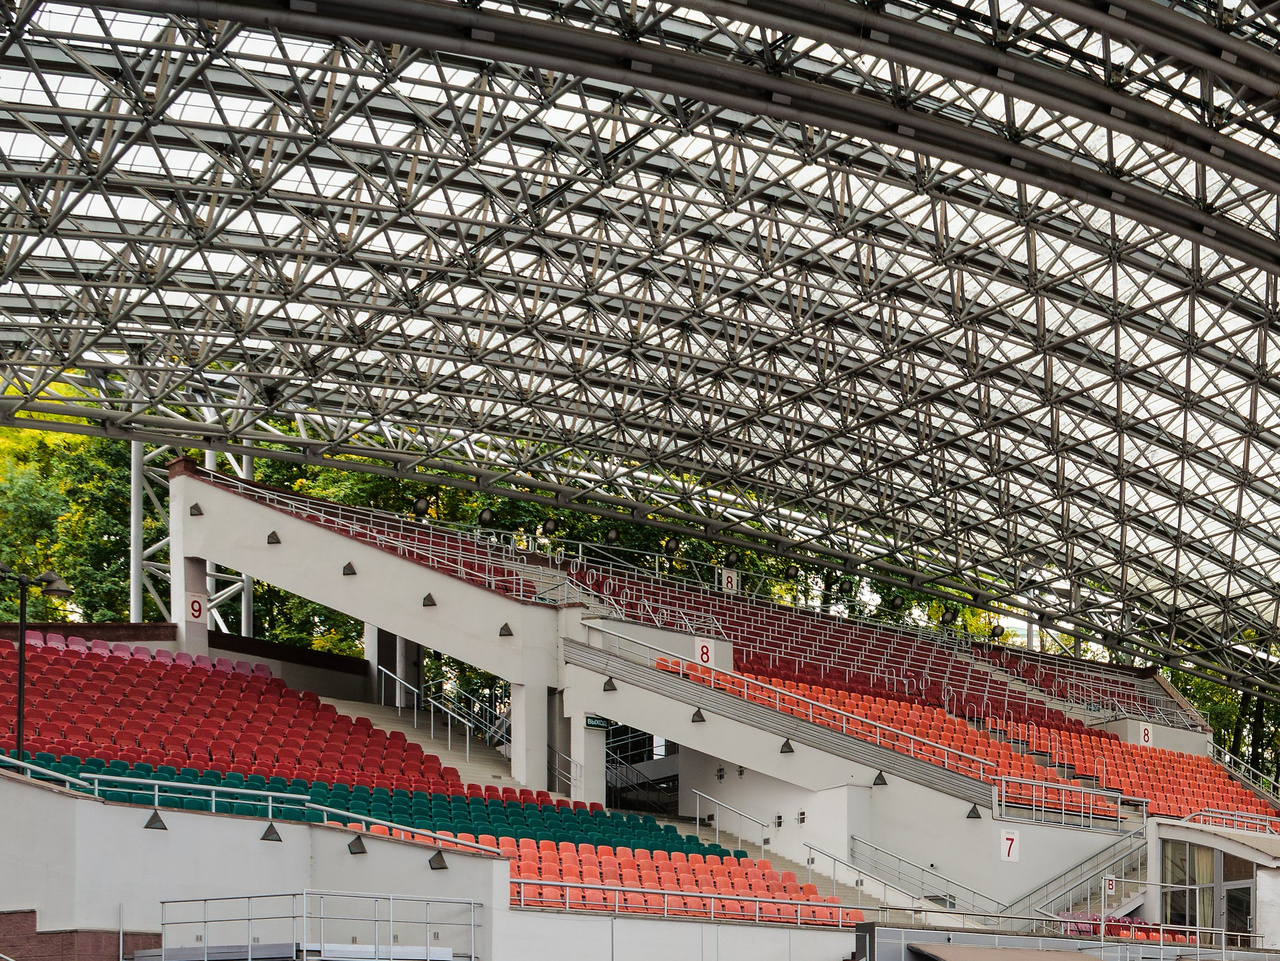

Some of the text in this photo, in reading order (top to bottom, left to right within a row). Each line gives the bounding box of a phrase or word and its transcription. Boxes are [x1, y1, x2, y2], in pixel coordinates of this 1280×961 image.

[726, 576, 733, 589] 8
[191, 600, 202, 619] 9
[700, 645, 710, 663] 8
[1143, 728, 1150, 743] 8
[1005, 837, 1015, 857] 7
